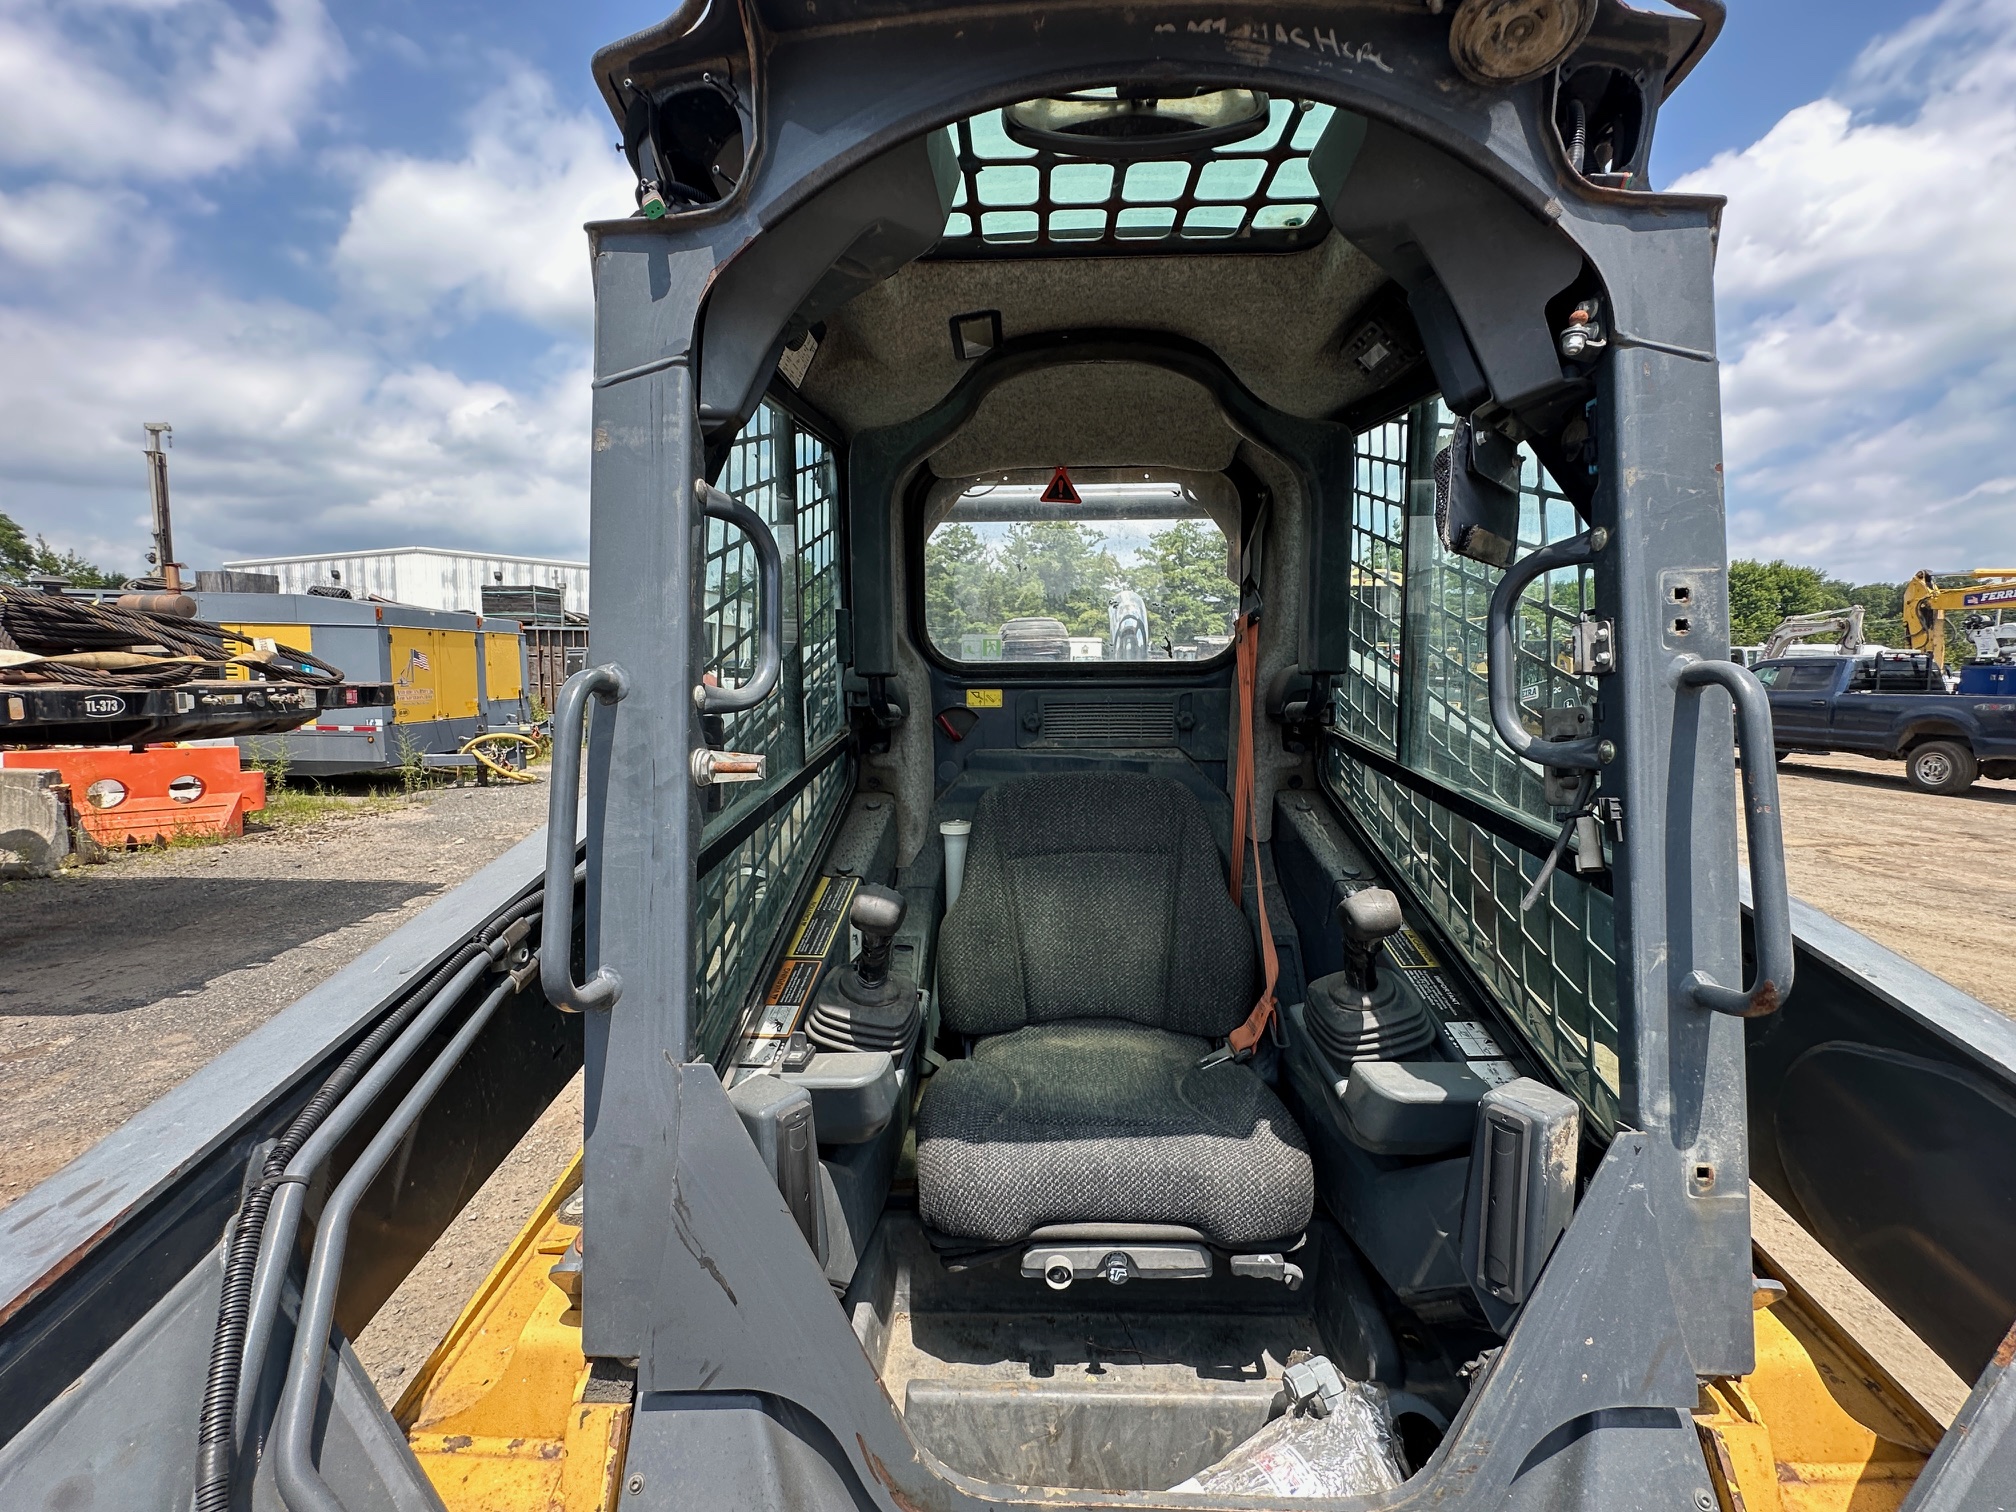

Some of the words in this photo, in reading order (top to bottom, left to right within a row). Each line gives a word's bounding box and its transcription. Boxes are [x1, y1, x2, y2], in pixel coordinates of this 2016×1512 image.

[1980, 589, 2016, 602] FERR
[84, 699, 118, 712] TL-373
[1434, 975, 1461, 1006] IMPORTANT
